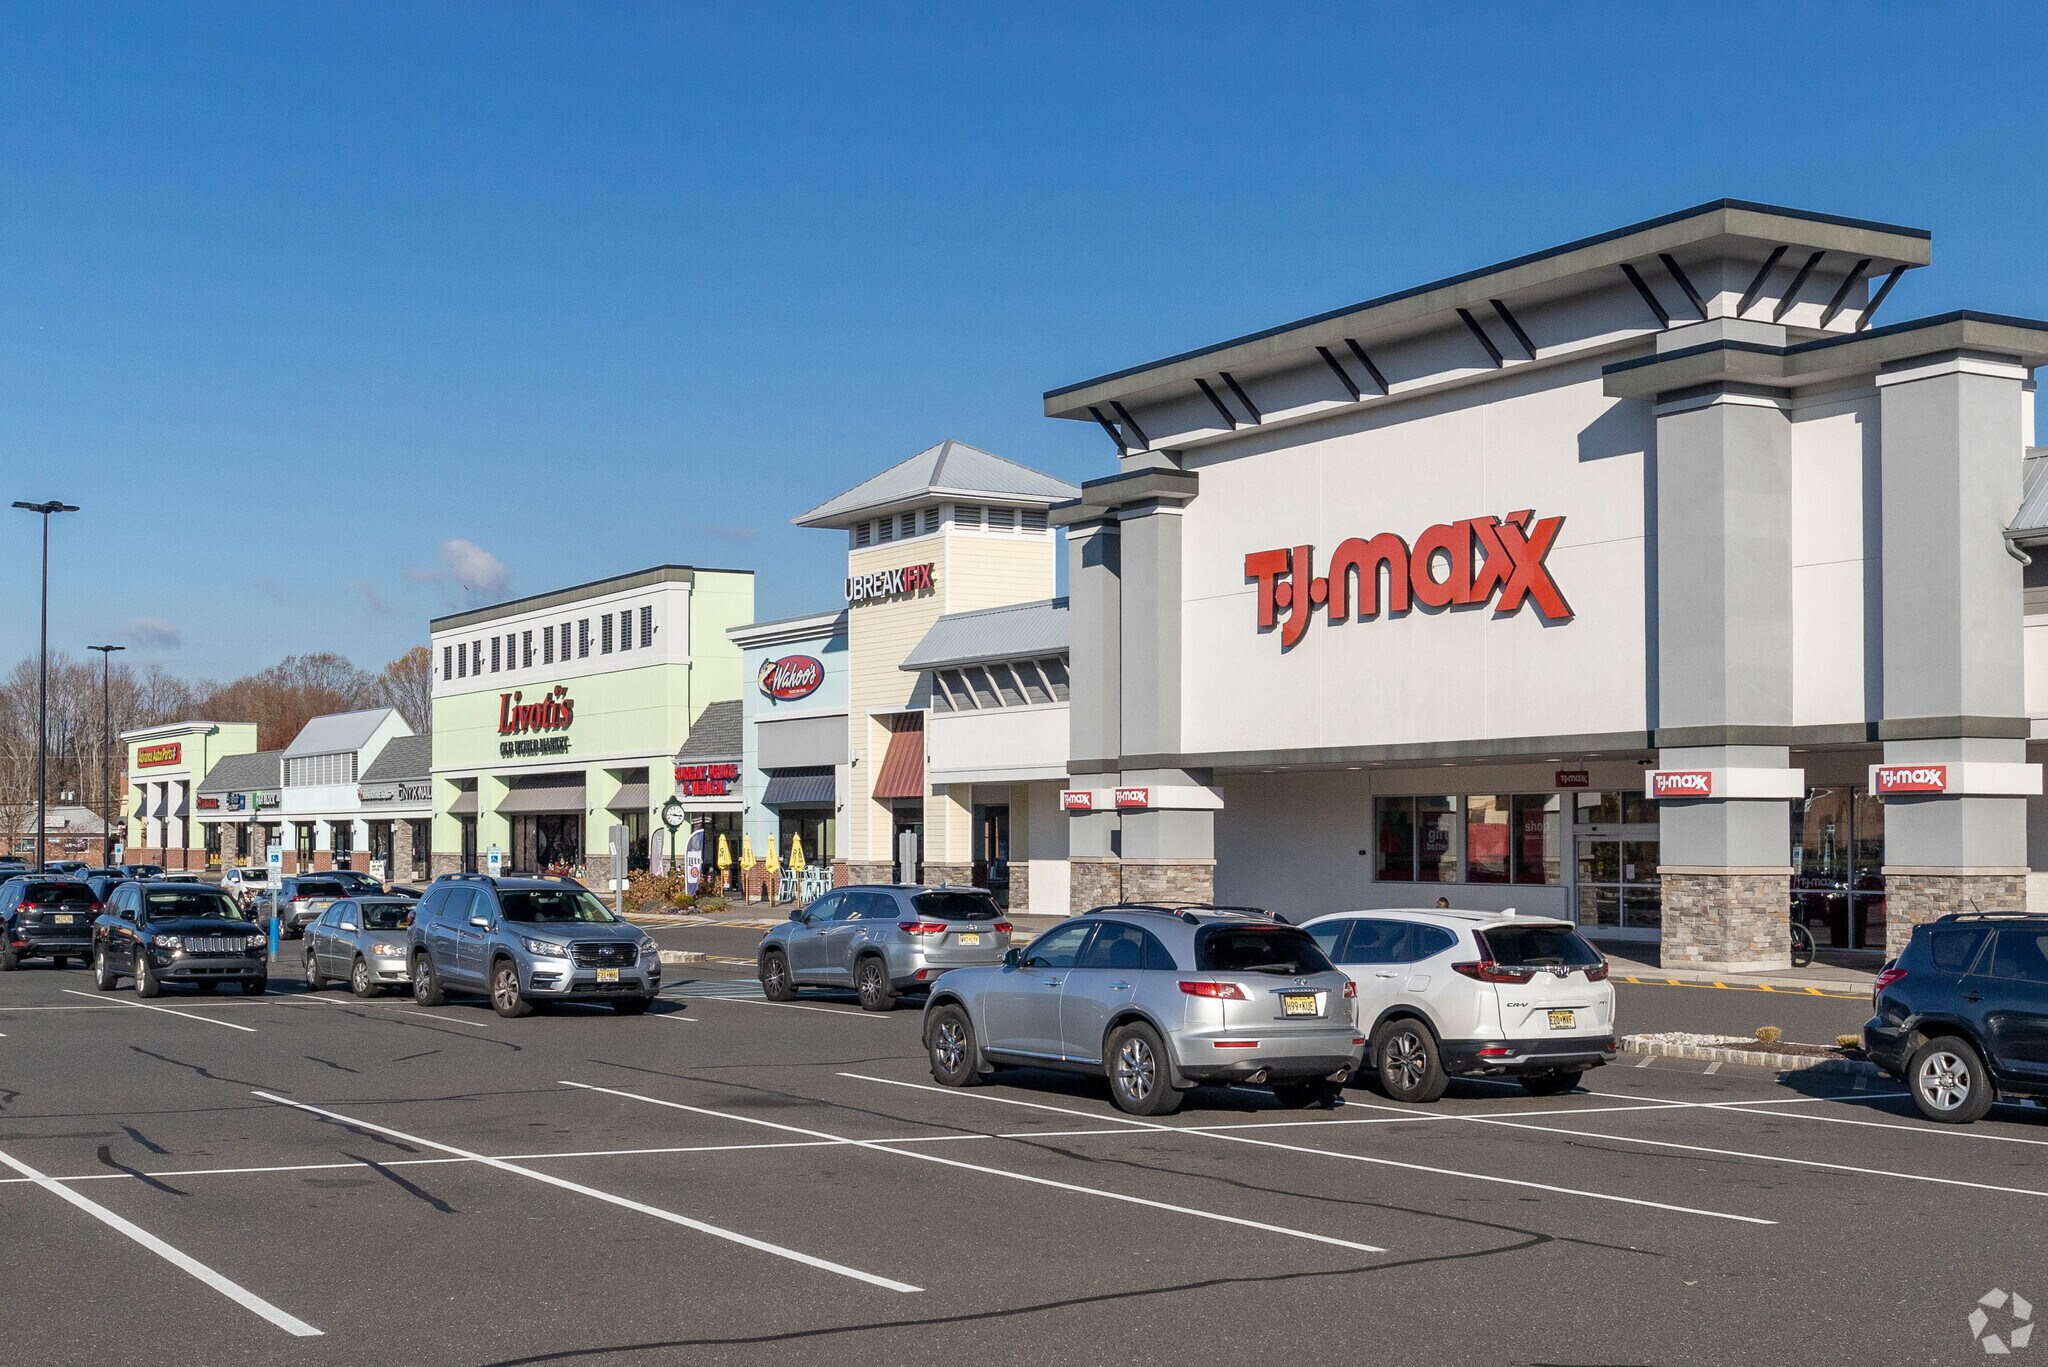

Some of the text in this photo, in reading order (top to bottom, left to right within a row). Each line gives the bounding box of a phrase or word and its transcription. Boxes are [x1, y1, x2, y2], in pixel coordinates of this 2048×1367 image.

[844, 562, 934, 602] UBREAKIFIX
[773, 662, 816, 691] Wahoo's
[498, 685, 574, 734] Livoti's
[539, 736, 570, 754] MARKET
[139, 751, 153, 763] Advance
[708, 764, 738, 779] DRUGS
[691, 780, 729, 796] MEDICAL
[1525, 820, 1550, 834] shop
